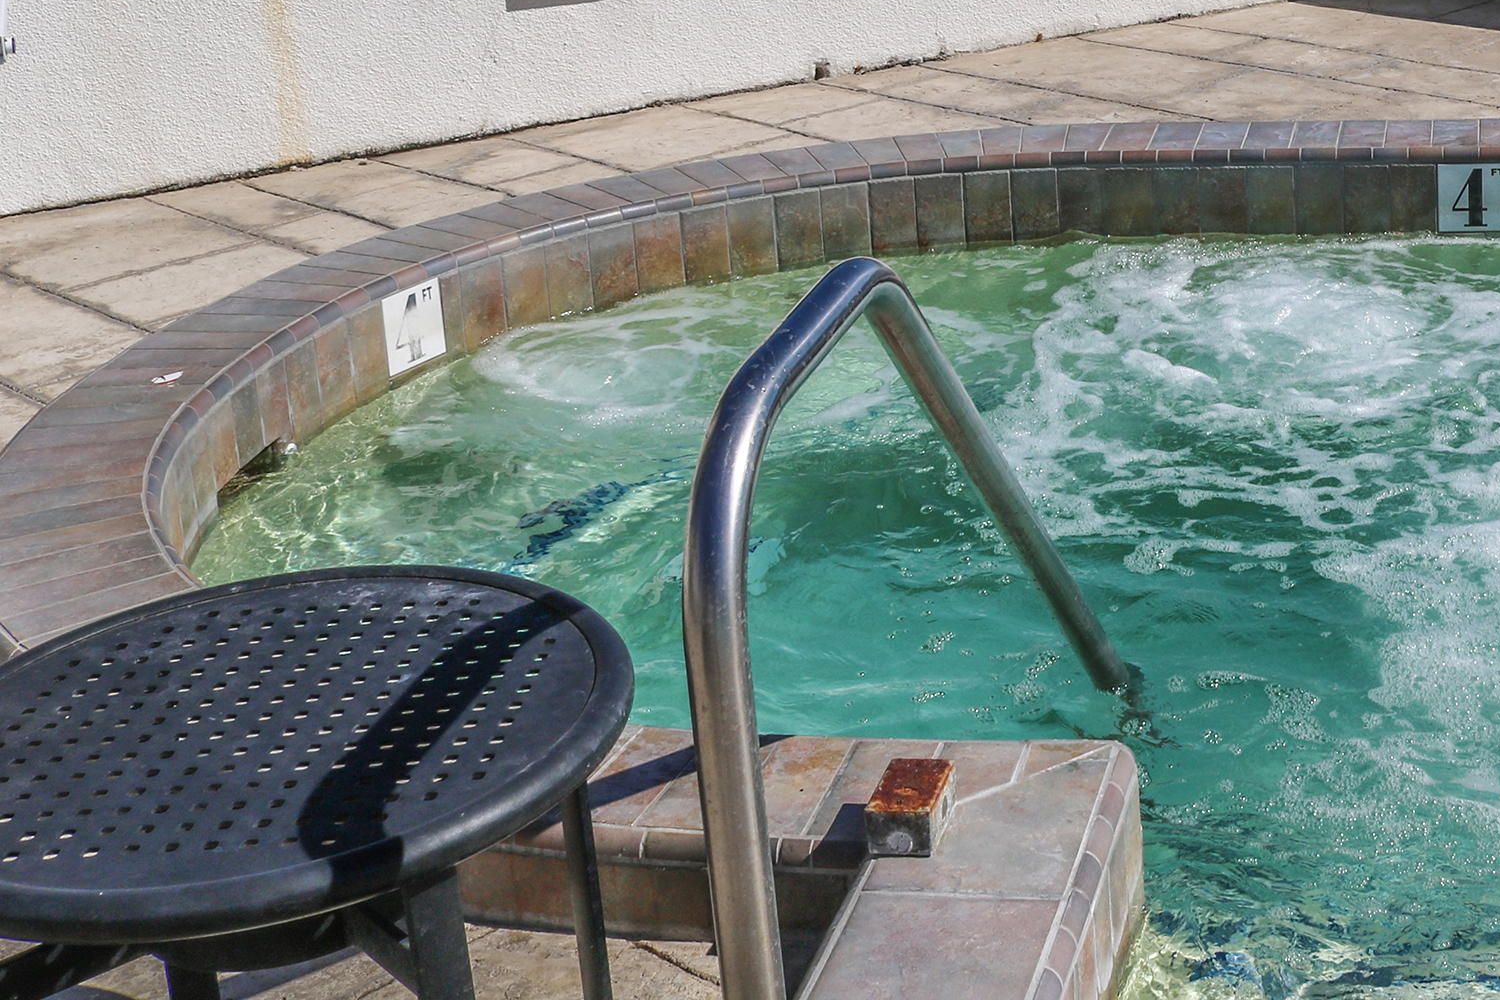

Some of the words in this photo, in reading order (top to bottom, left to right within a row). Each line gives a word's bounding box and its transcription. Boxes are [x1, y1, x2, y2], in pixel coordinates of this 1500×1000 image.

[1452, 169, 1488, 227] 4
[396, 293, 426, 363] 4
[422, 286, 432, 303] FT
